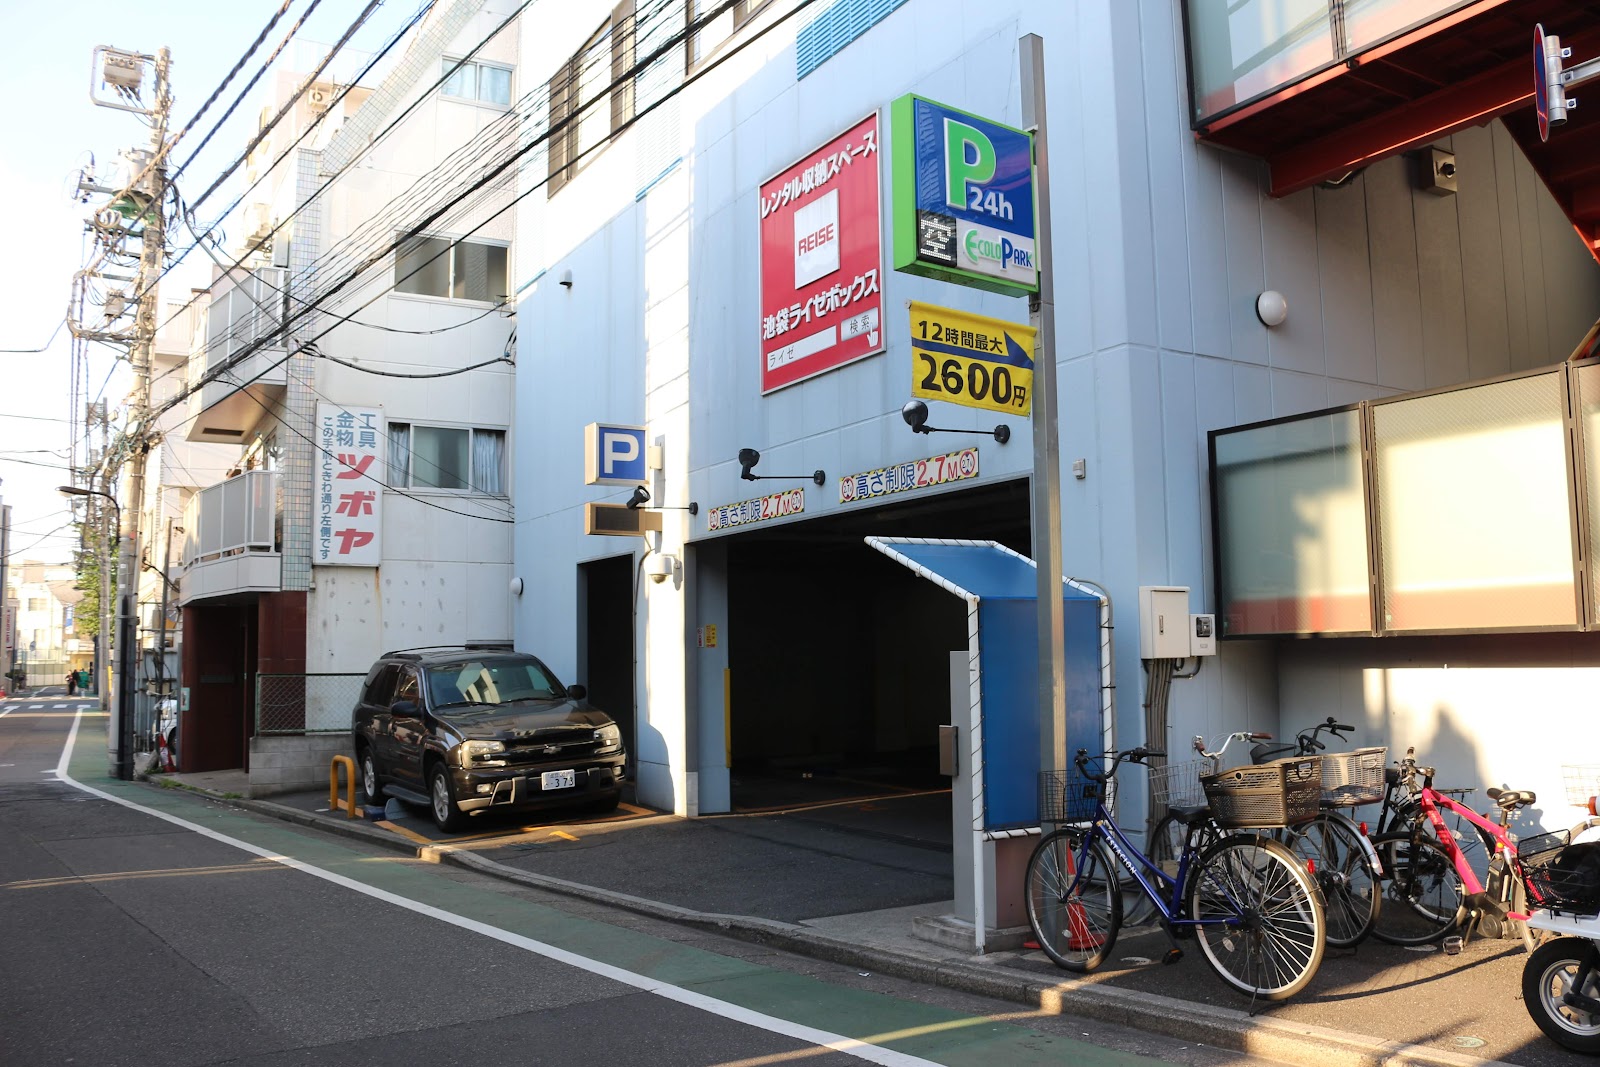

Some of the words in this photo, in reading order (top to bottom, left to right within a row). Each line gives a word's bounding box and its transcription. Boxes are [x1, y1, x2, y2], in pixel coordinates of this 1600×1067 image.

[761, 129, 878, 219] レンタル収納スペース
[943, 117, 997, 211] P
[970, 186, 1014, 221] 24h
[798, 222, 834, 257] REISE
[920, 217, 952, 261] 空
[762, 268, 880, 340] 池袋ライゼボックス
[849, 314, 870, 335] 検索
[769, 345, 795, 367] ライゼ
[918, 320, 1003, 354] 12時間最大
[919, 352, 1026, 408] 2600円
[603, 432, 640, 474] P
[334, 453, 376, 555] ツボヤ
